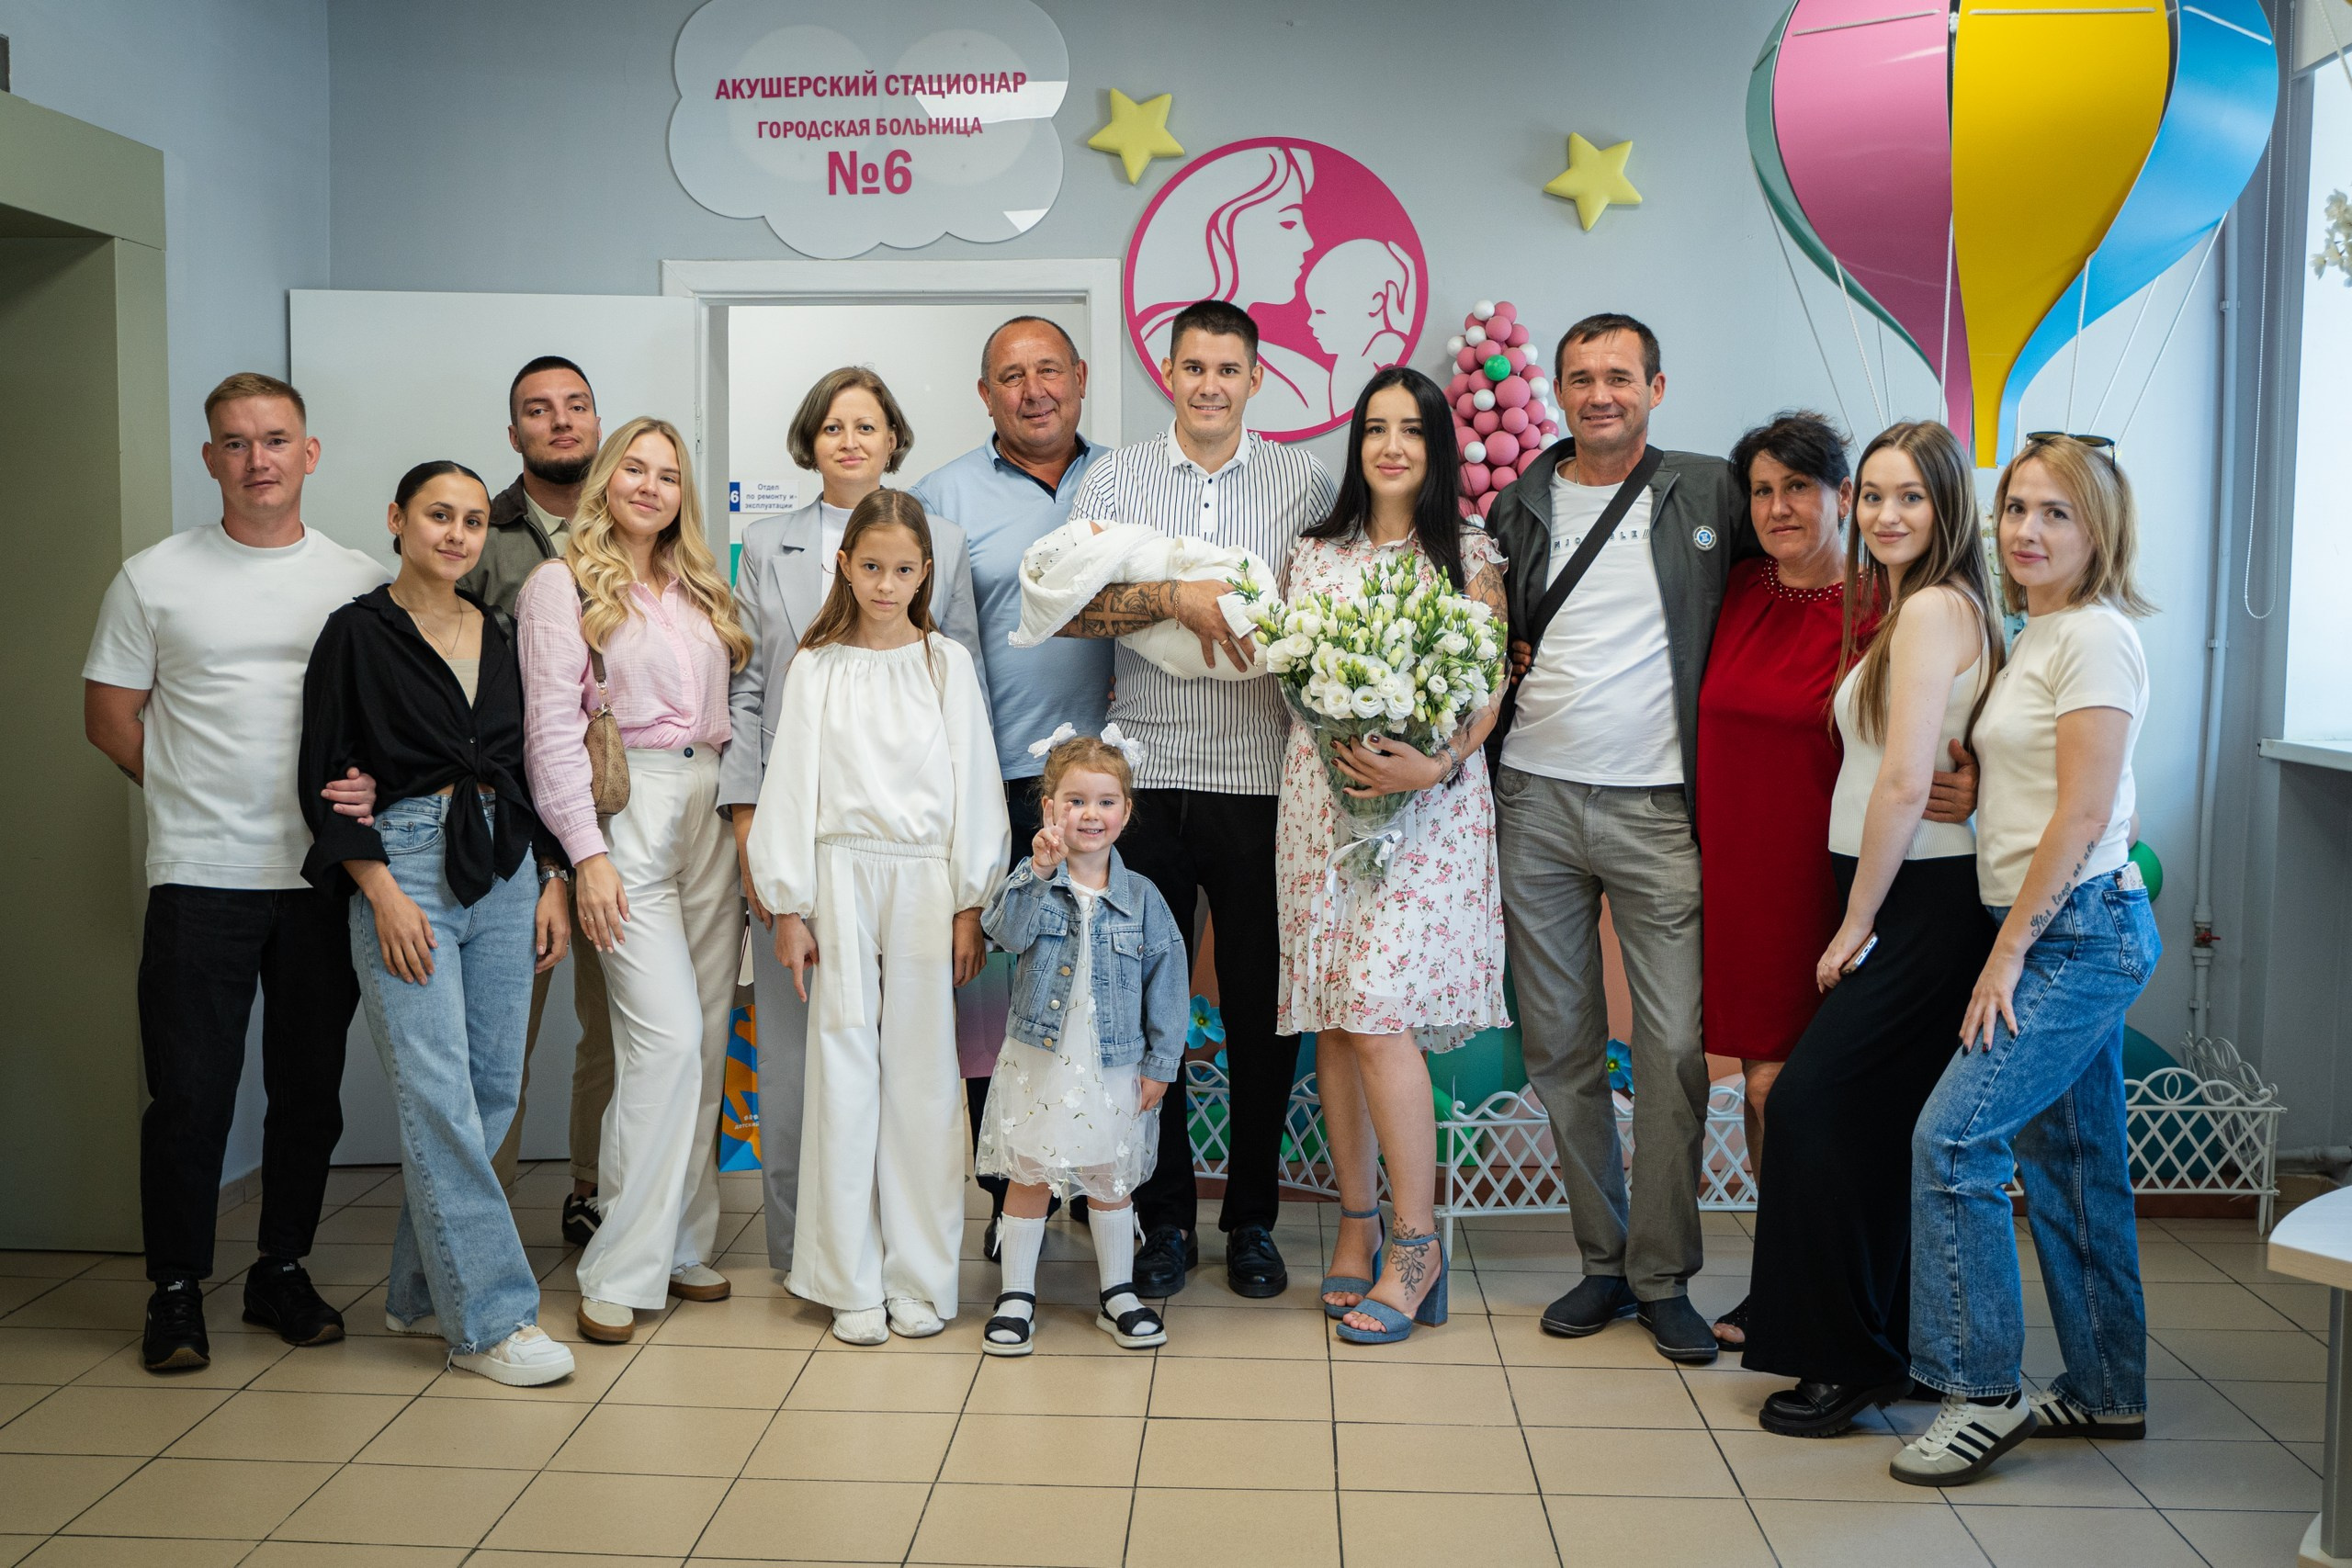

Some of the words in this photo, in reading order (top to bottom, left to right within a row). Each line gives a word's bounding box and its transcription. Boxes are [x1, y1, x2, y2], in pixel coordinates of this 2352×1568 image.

[715, 70, 877, 99] АКУШЕРСКИЙ
[885, 72, 1027, 98] СТАЦИОНАР
[757, 118, 870, 140] ГОРОДСКАЯ
[876, 118, 983, 137] БОЛЬНИЦА
[828, 149, 913, 196] №6
[729, 490, 740, 503] 6
